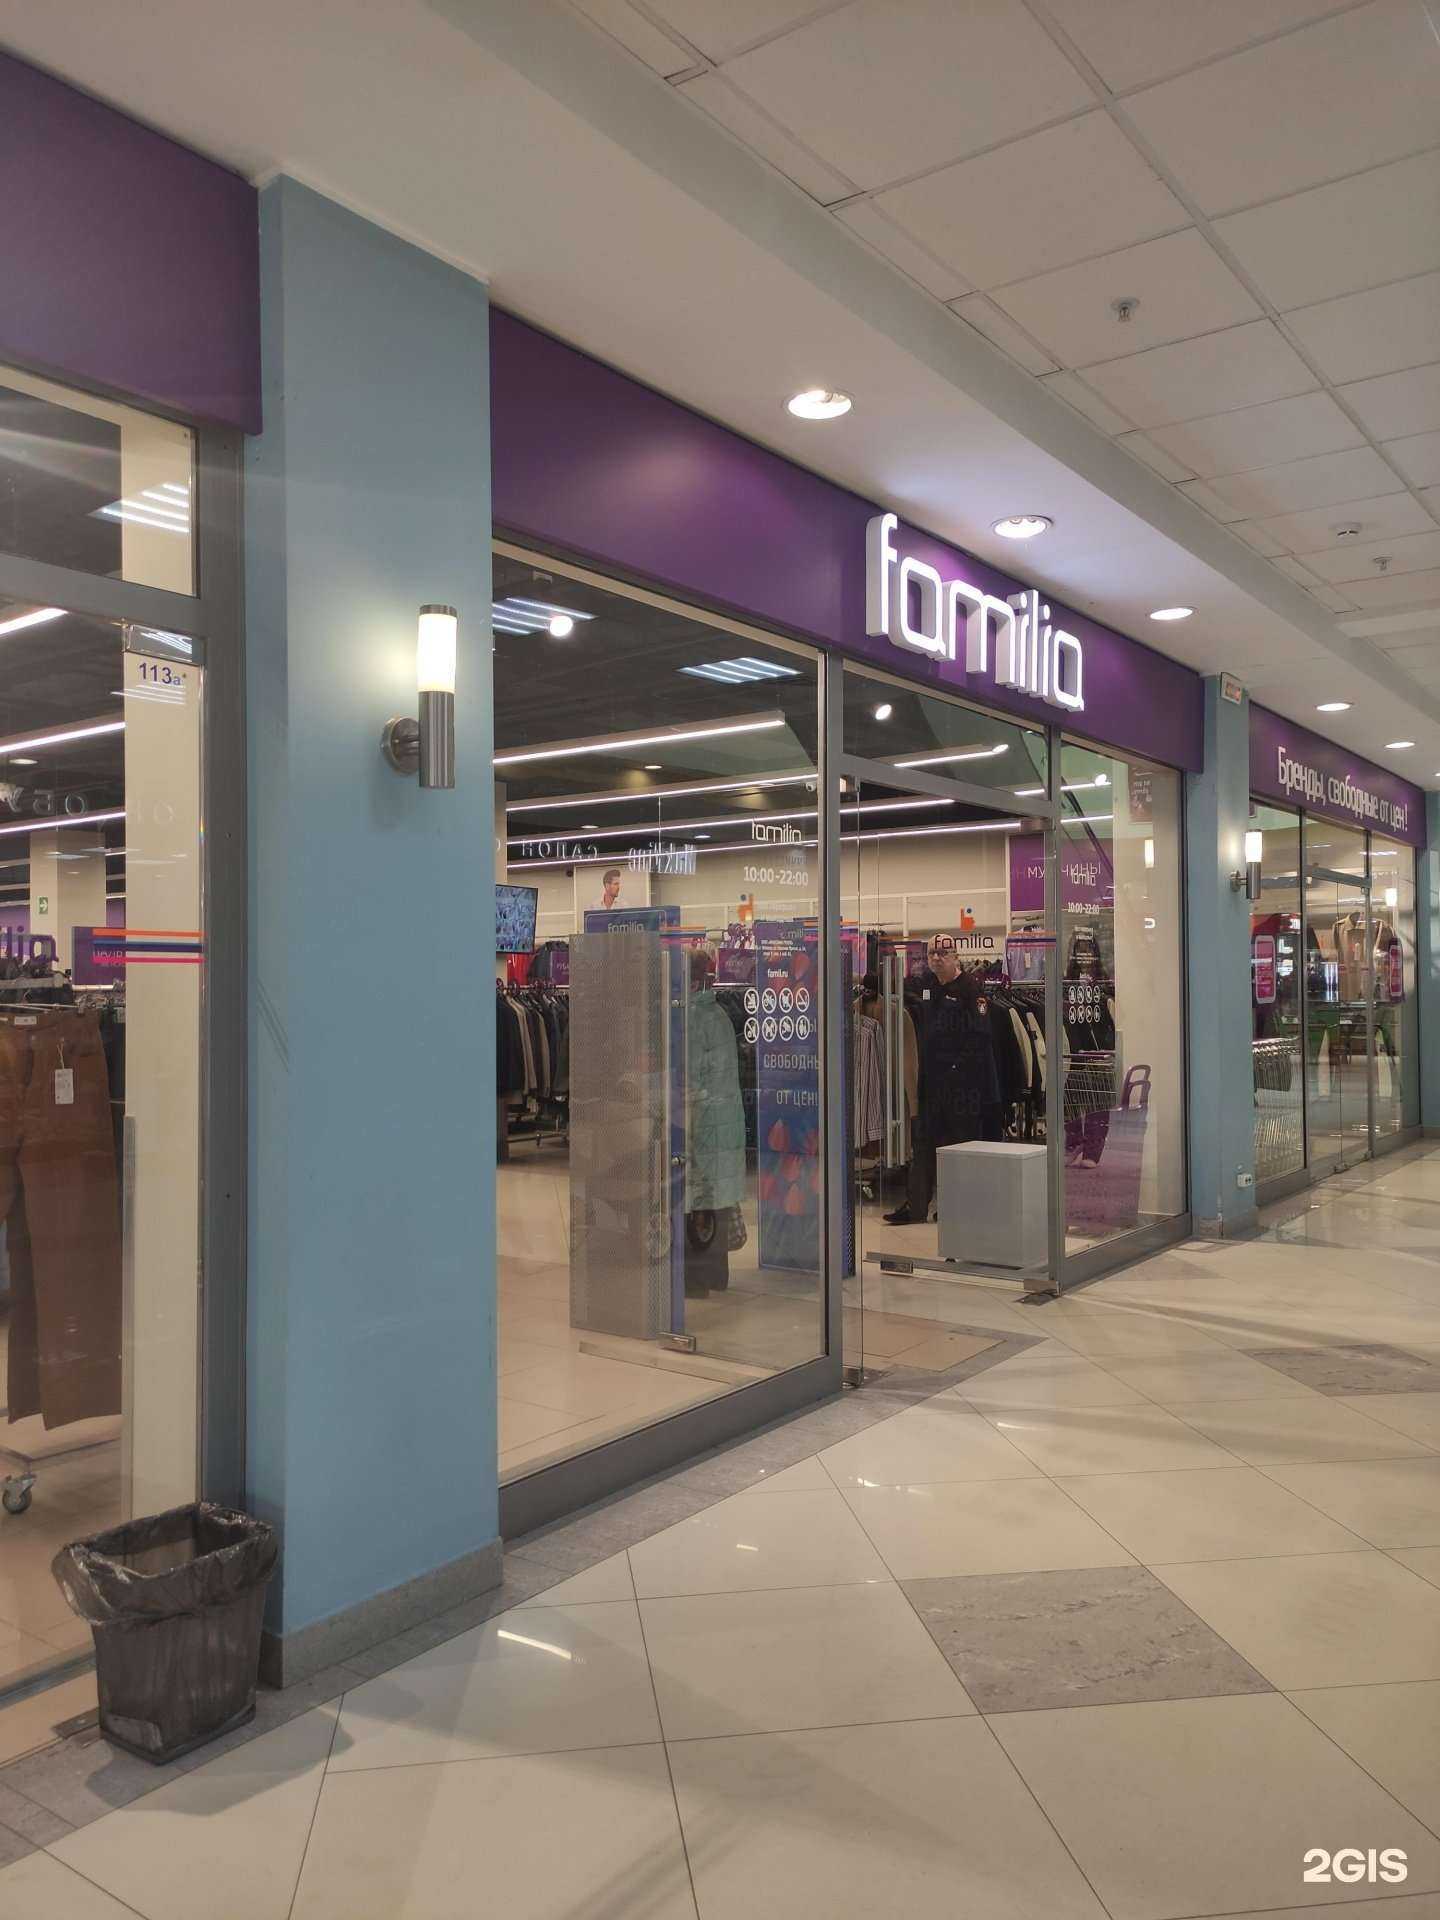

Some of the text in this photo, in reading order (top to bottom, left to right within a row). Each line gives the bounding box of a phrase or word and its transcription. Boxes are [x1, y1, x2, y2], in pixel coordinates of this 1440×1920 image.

[866, 512, 1085, 712] familia
[1278, 746, 1408, 832] Бренды, свободные от цен!
[743, 866, 809, 887] 10:00-22:00
[1027, 862, 1101, 879] МУЧИНЫ
[934, 933, 994, 949] familia
